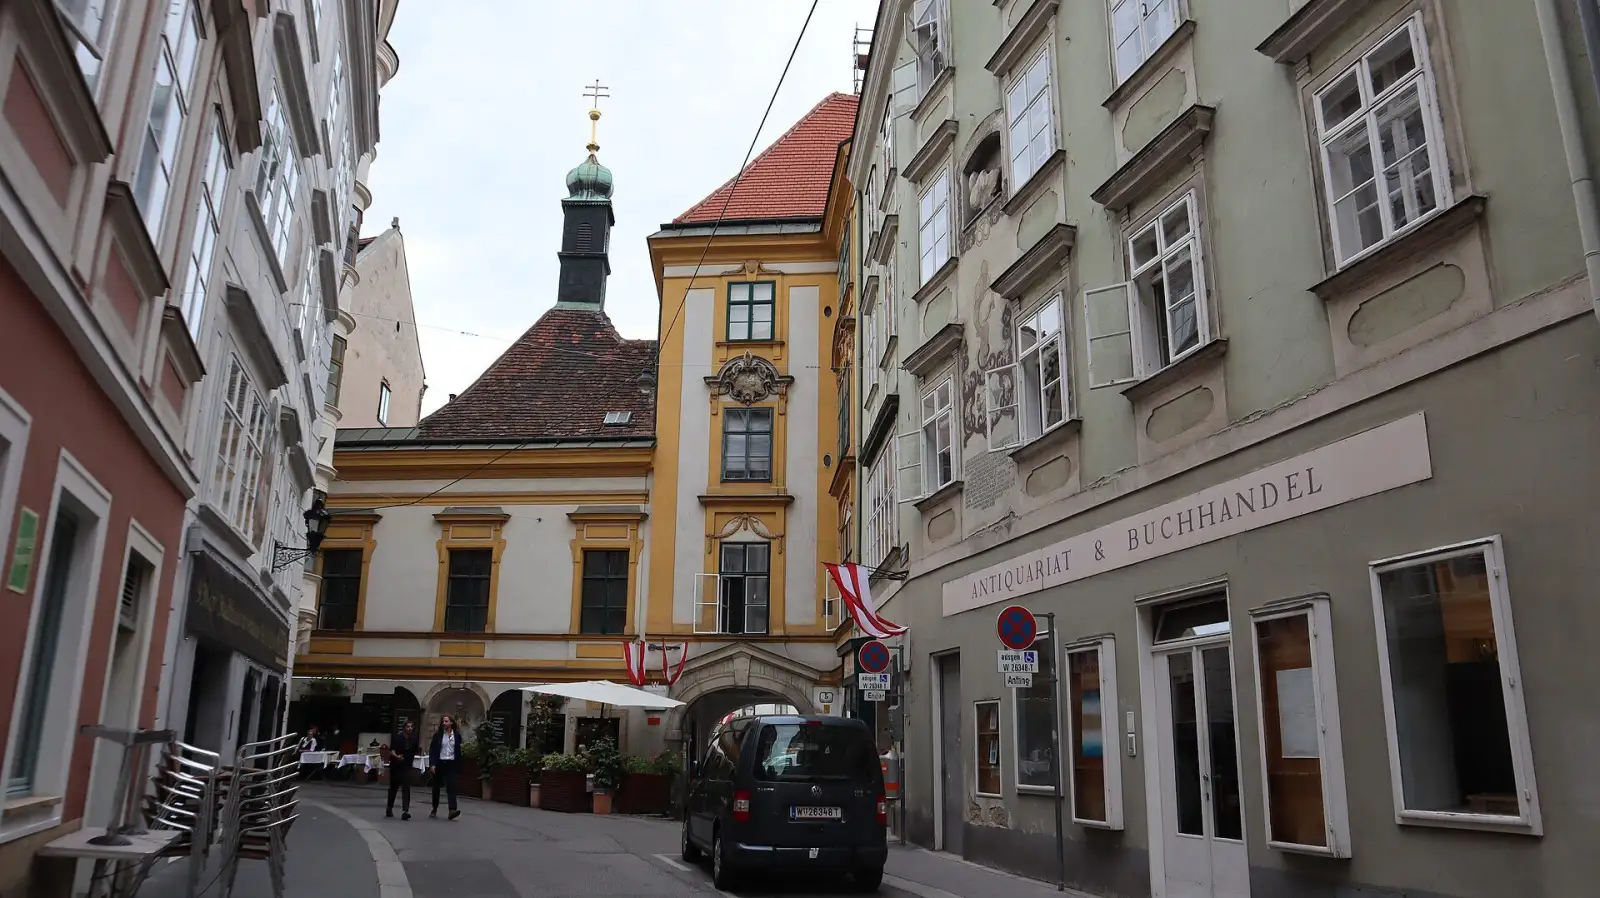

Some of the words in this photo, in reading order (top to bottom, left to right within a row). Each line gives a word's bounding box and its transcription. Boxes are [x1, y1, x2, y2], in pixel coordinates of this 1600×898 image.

[971, 549, 1072, 599] ANTIQUARIAT
[1094, 538, 1106, 561] &
[1127, 467, 1323, 551] BUCHHANDEL
[797, 807, 803, 816] W
[809, 807, 833, 816] 26348
